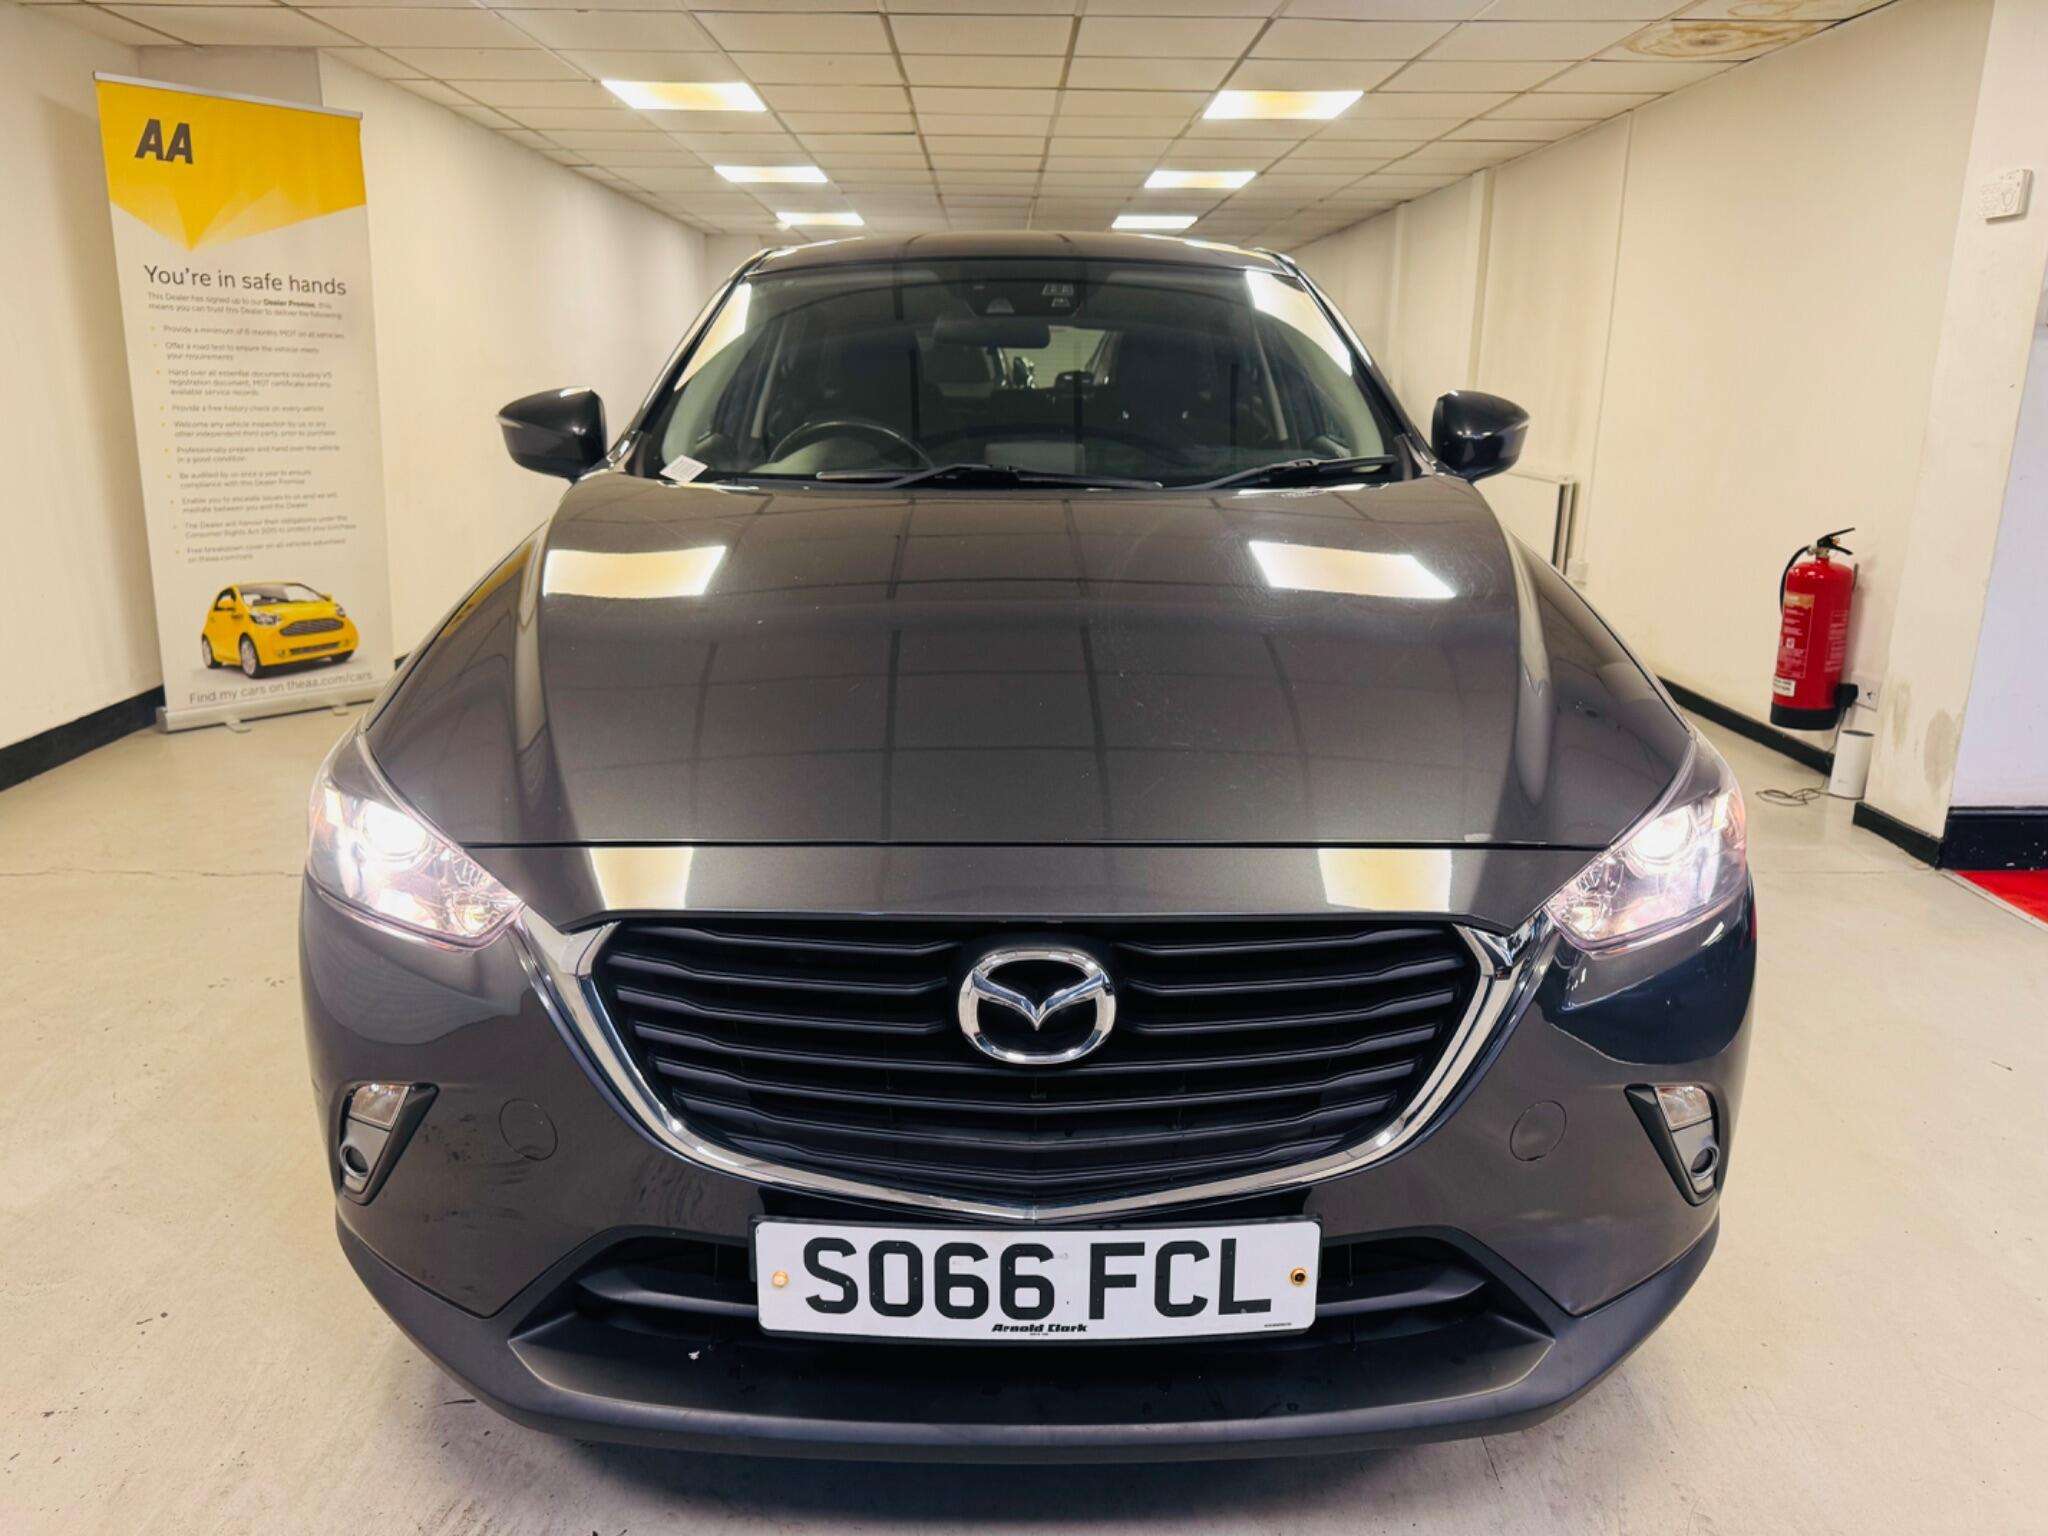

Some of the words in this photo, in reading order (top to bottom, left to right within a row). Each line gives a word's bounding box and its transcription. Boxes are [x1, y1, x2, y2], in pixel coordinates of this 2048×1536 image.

[134, 119, 194, 164] AA
[218, 270, 236, 288] in
[242, 273, 282, 292] safe
[289, 275, 346, 295] hands
[190, 690, 216, 704] Find
[220, 686, 237, 700] my
[241, 684, 266, 697] cars
[269, 682, 284, 692] on
[287, 671, 373, 691] theaa.com/cars
[803, 1237, 1054, 1319] SO66
[1088, 1238, 1272, 1320] FCL
[992, 1323, 1044, 1332] Arnold
[1047, 1323, 1088, 1332] Clark
